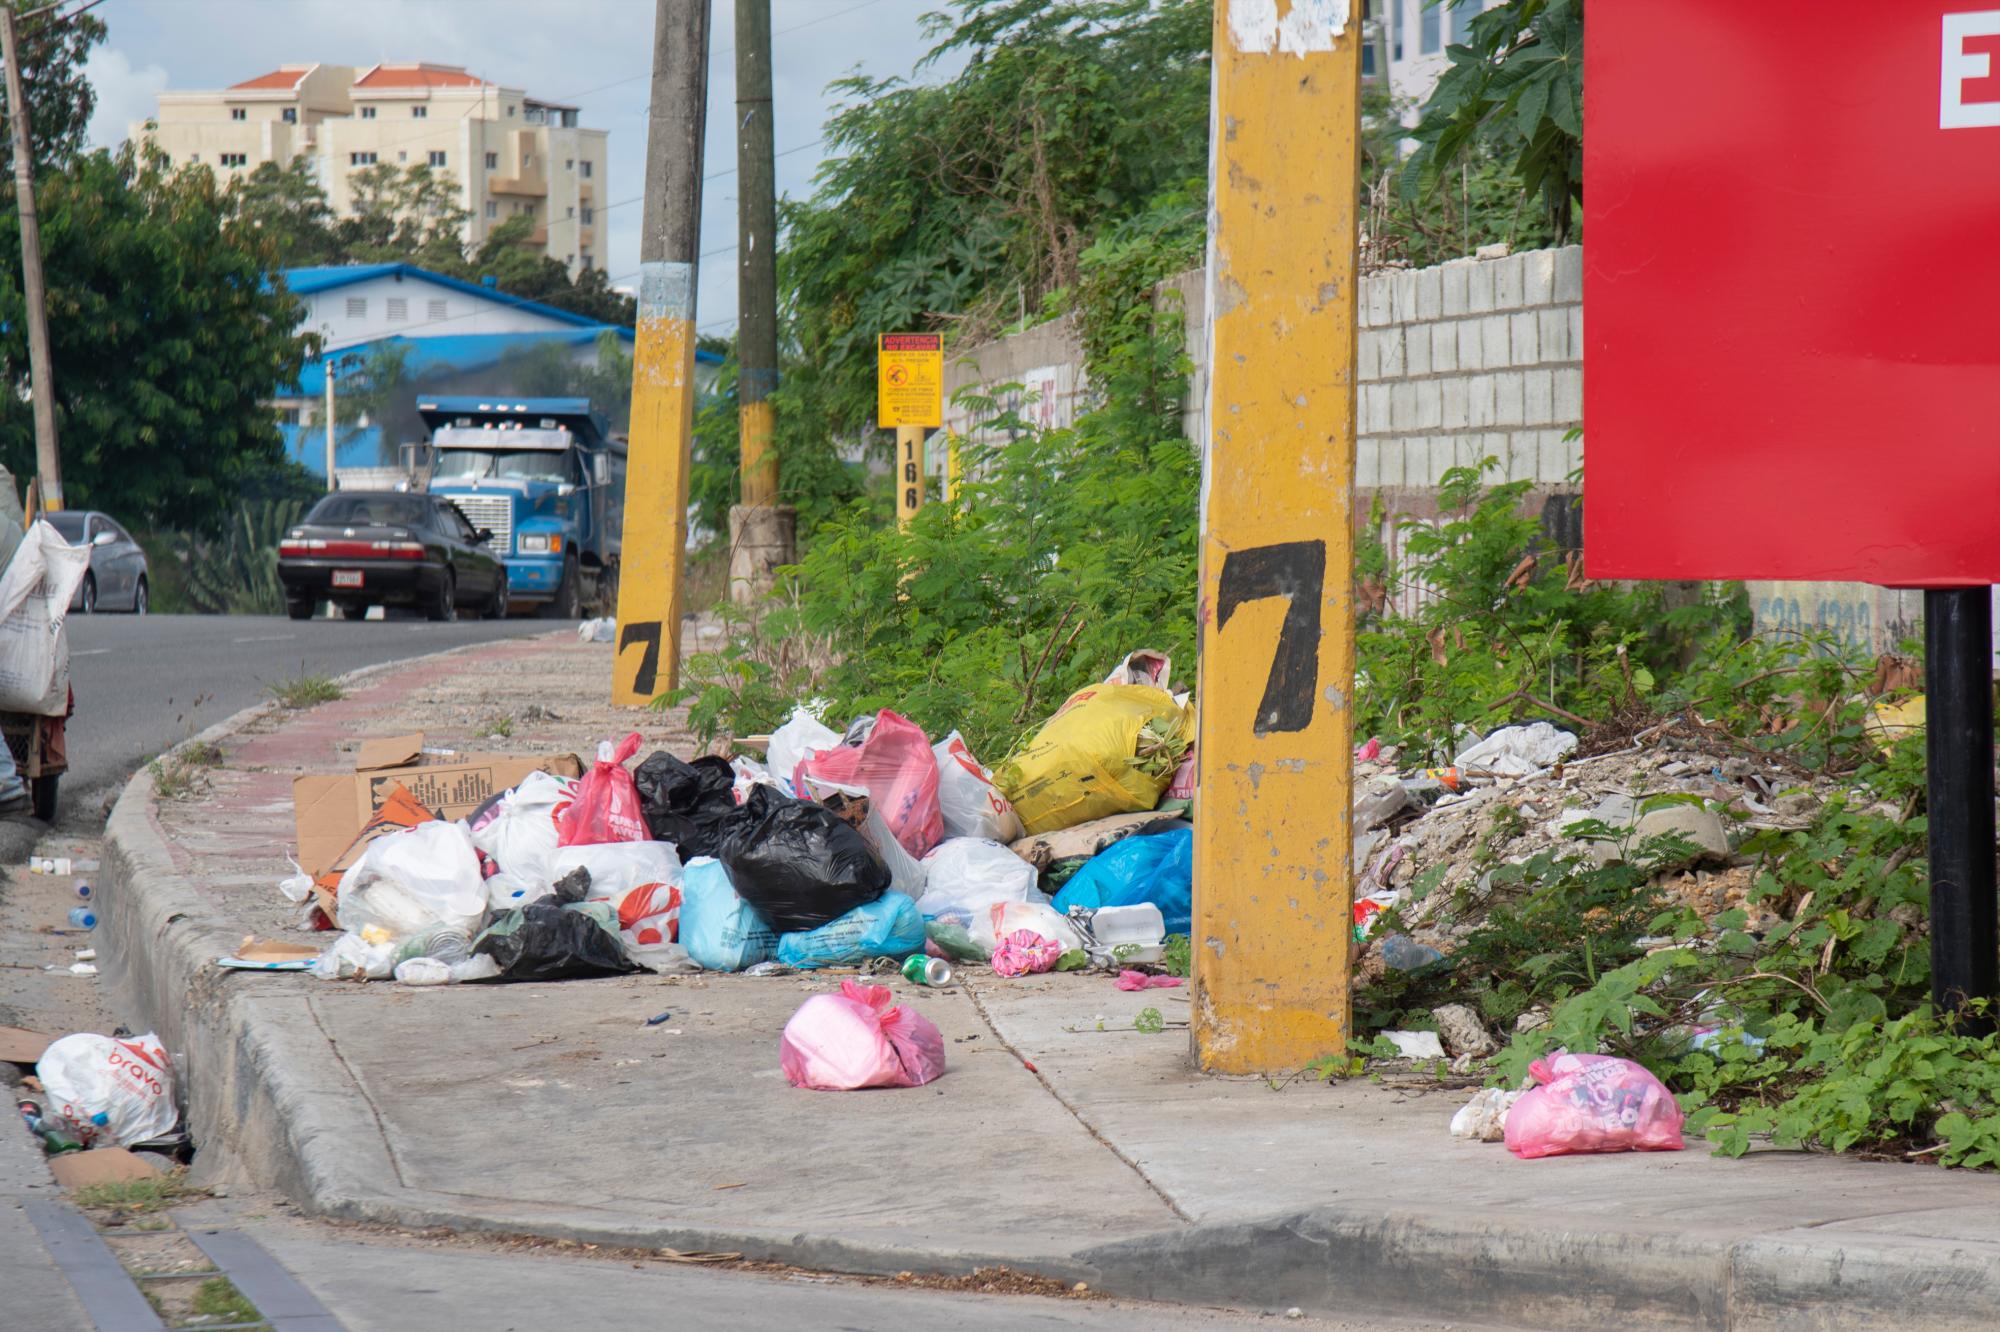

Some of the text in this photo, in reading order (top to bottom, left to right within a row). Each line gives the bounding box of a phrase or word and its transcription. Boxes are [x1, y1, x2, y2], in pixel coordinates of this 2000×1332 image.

[1939, 9, 2000, 130] E
[619, 621, 661, 695] 7
[1217, 539, 1326, 733] 7
[108, 1047, 162, 1096] bravo
